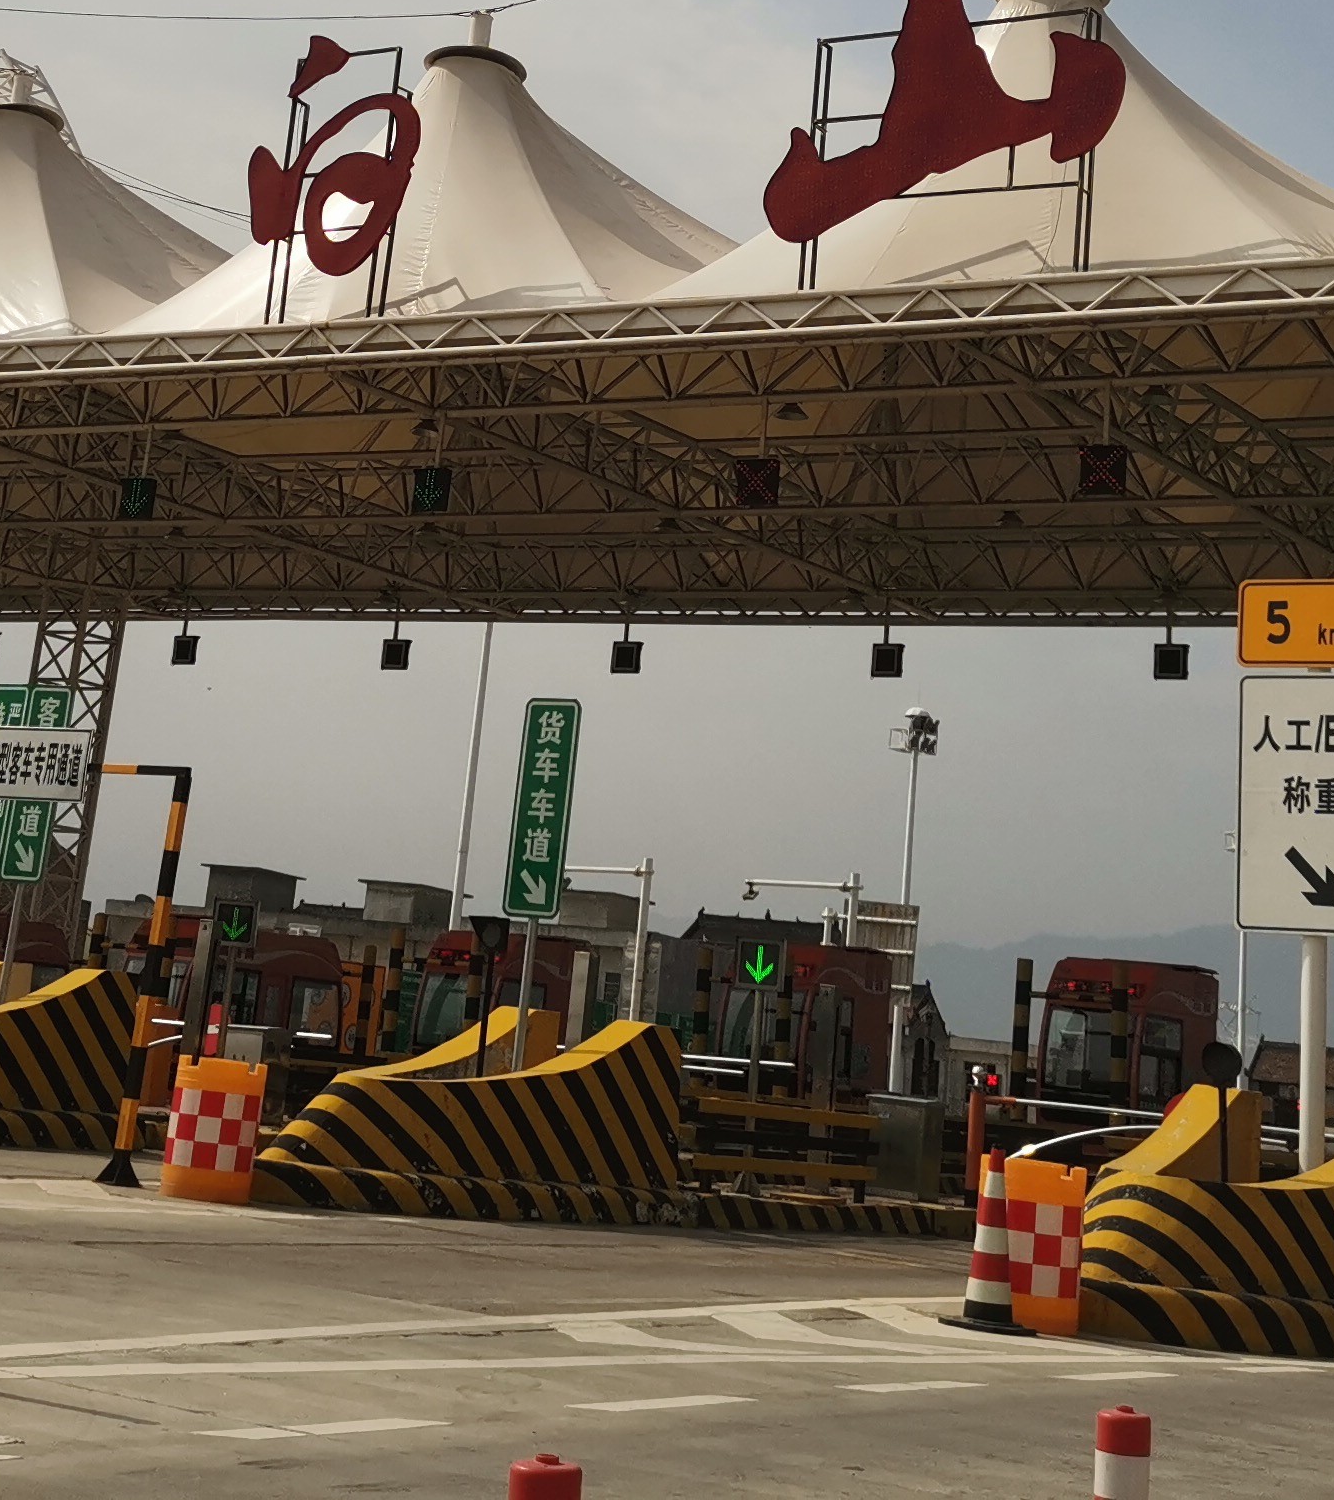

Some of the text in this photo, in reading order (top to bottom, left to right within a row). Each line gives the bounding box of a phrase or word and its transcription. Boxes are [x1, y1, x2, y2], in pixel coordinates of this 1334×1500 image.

[1266, 600, 1291, 645] 5
[521, 710, 565, 863] 货车车道
